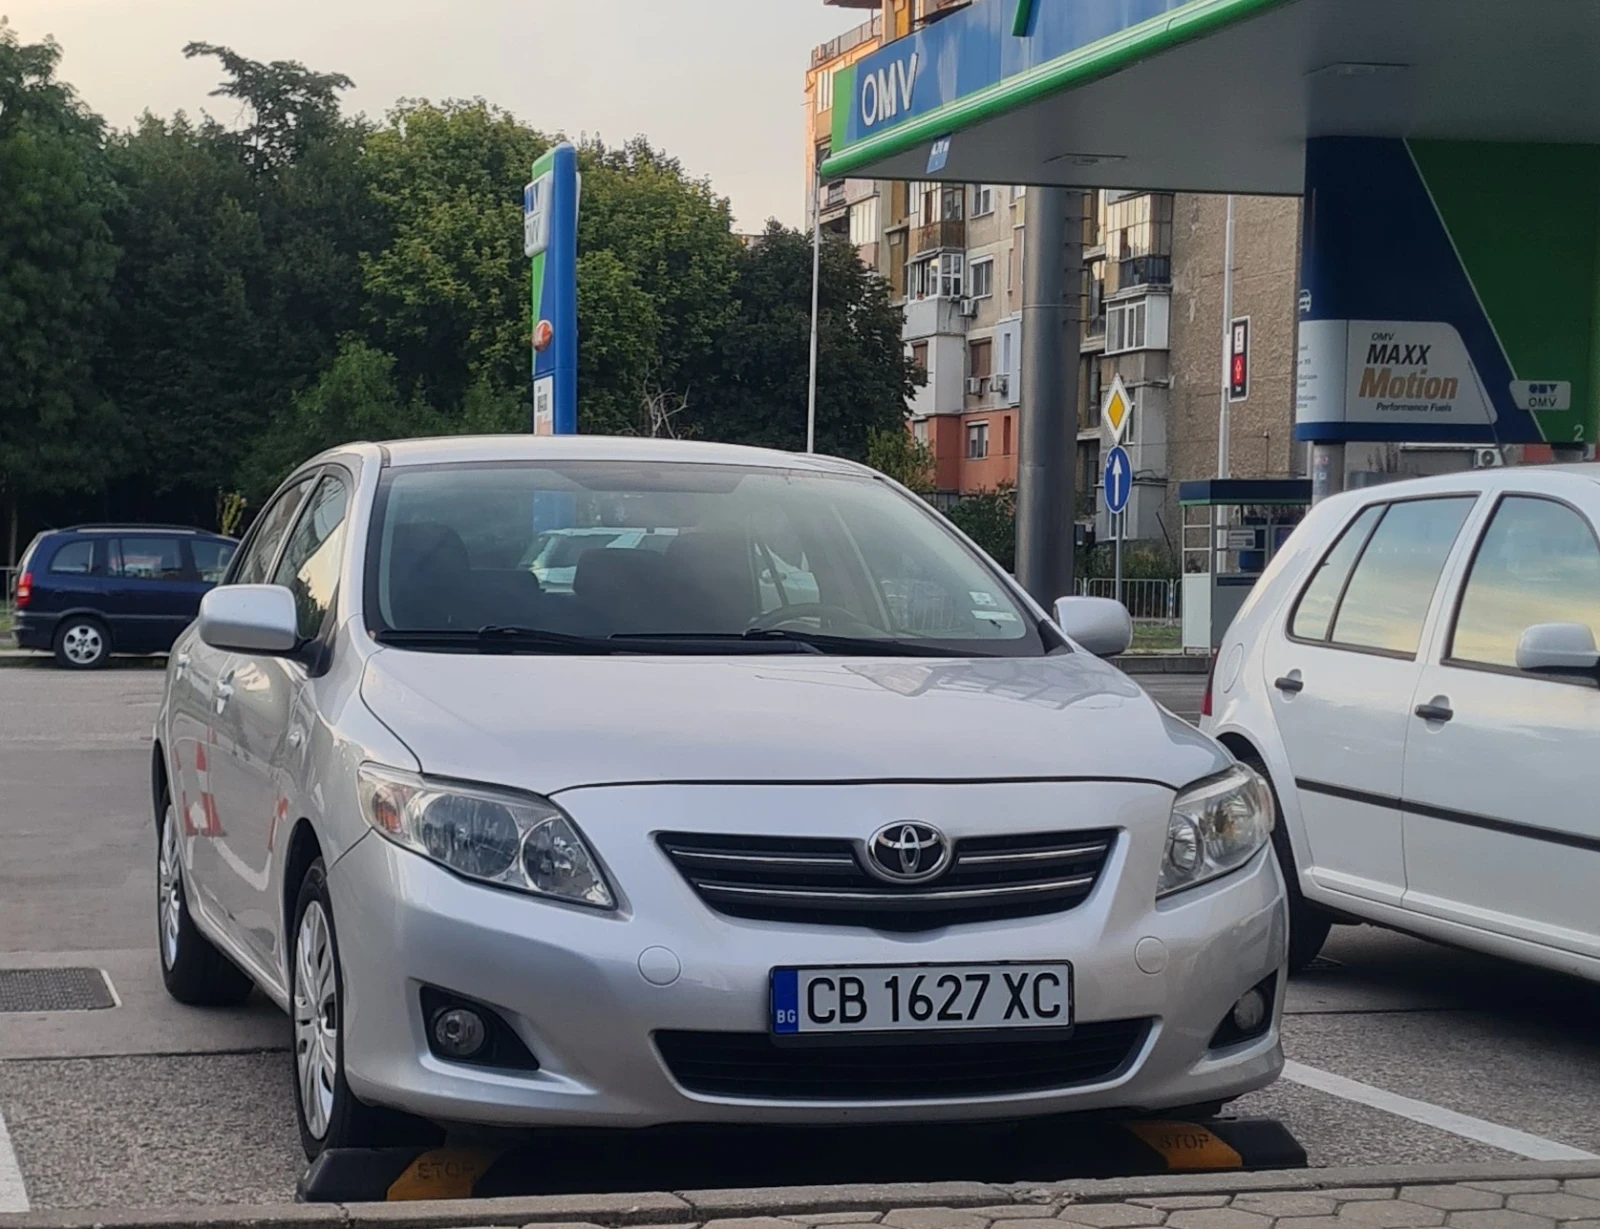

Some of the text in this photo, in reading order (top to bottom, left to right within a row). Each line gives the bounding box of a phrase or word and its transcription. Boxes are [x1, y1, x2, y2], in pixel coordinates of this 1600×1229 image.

[861, 52, 919, 127] OMV
[1371, 332, 1395, 341] OMV
[1366, 343, 1432, 365] MAXX
[1359, 367, 1459, 400] Motion
[1376, 402, 1453, 412] Performance Fuels
[1528, 397, 1557, 408] OMV
[1573, 424, 1585, 442] 2
[807, 972, 1060, 1024] CB 1627 XC
[777, 1009, 796, 1023] BG
[1160, 1133, 1209, 1149] STOP
